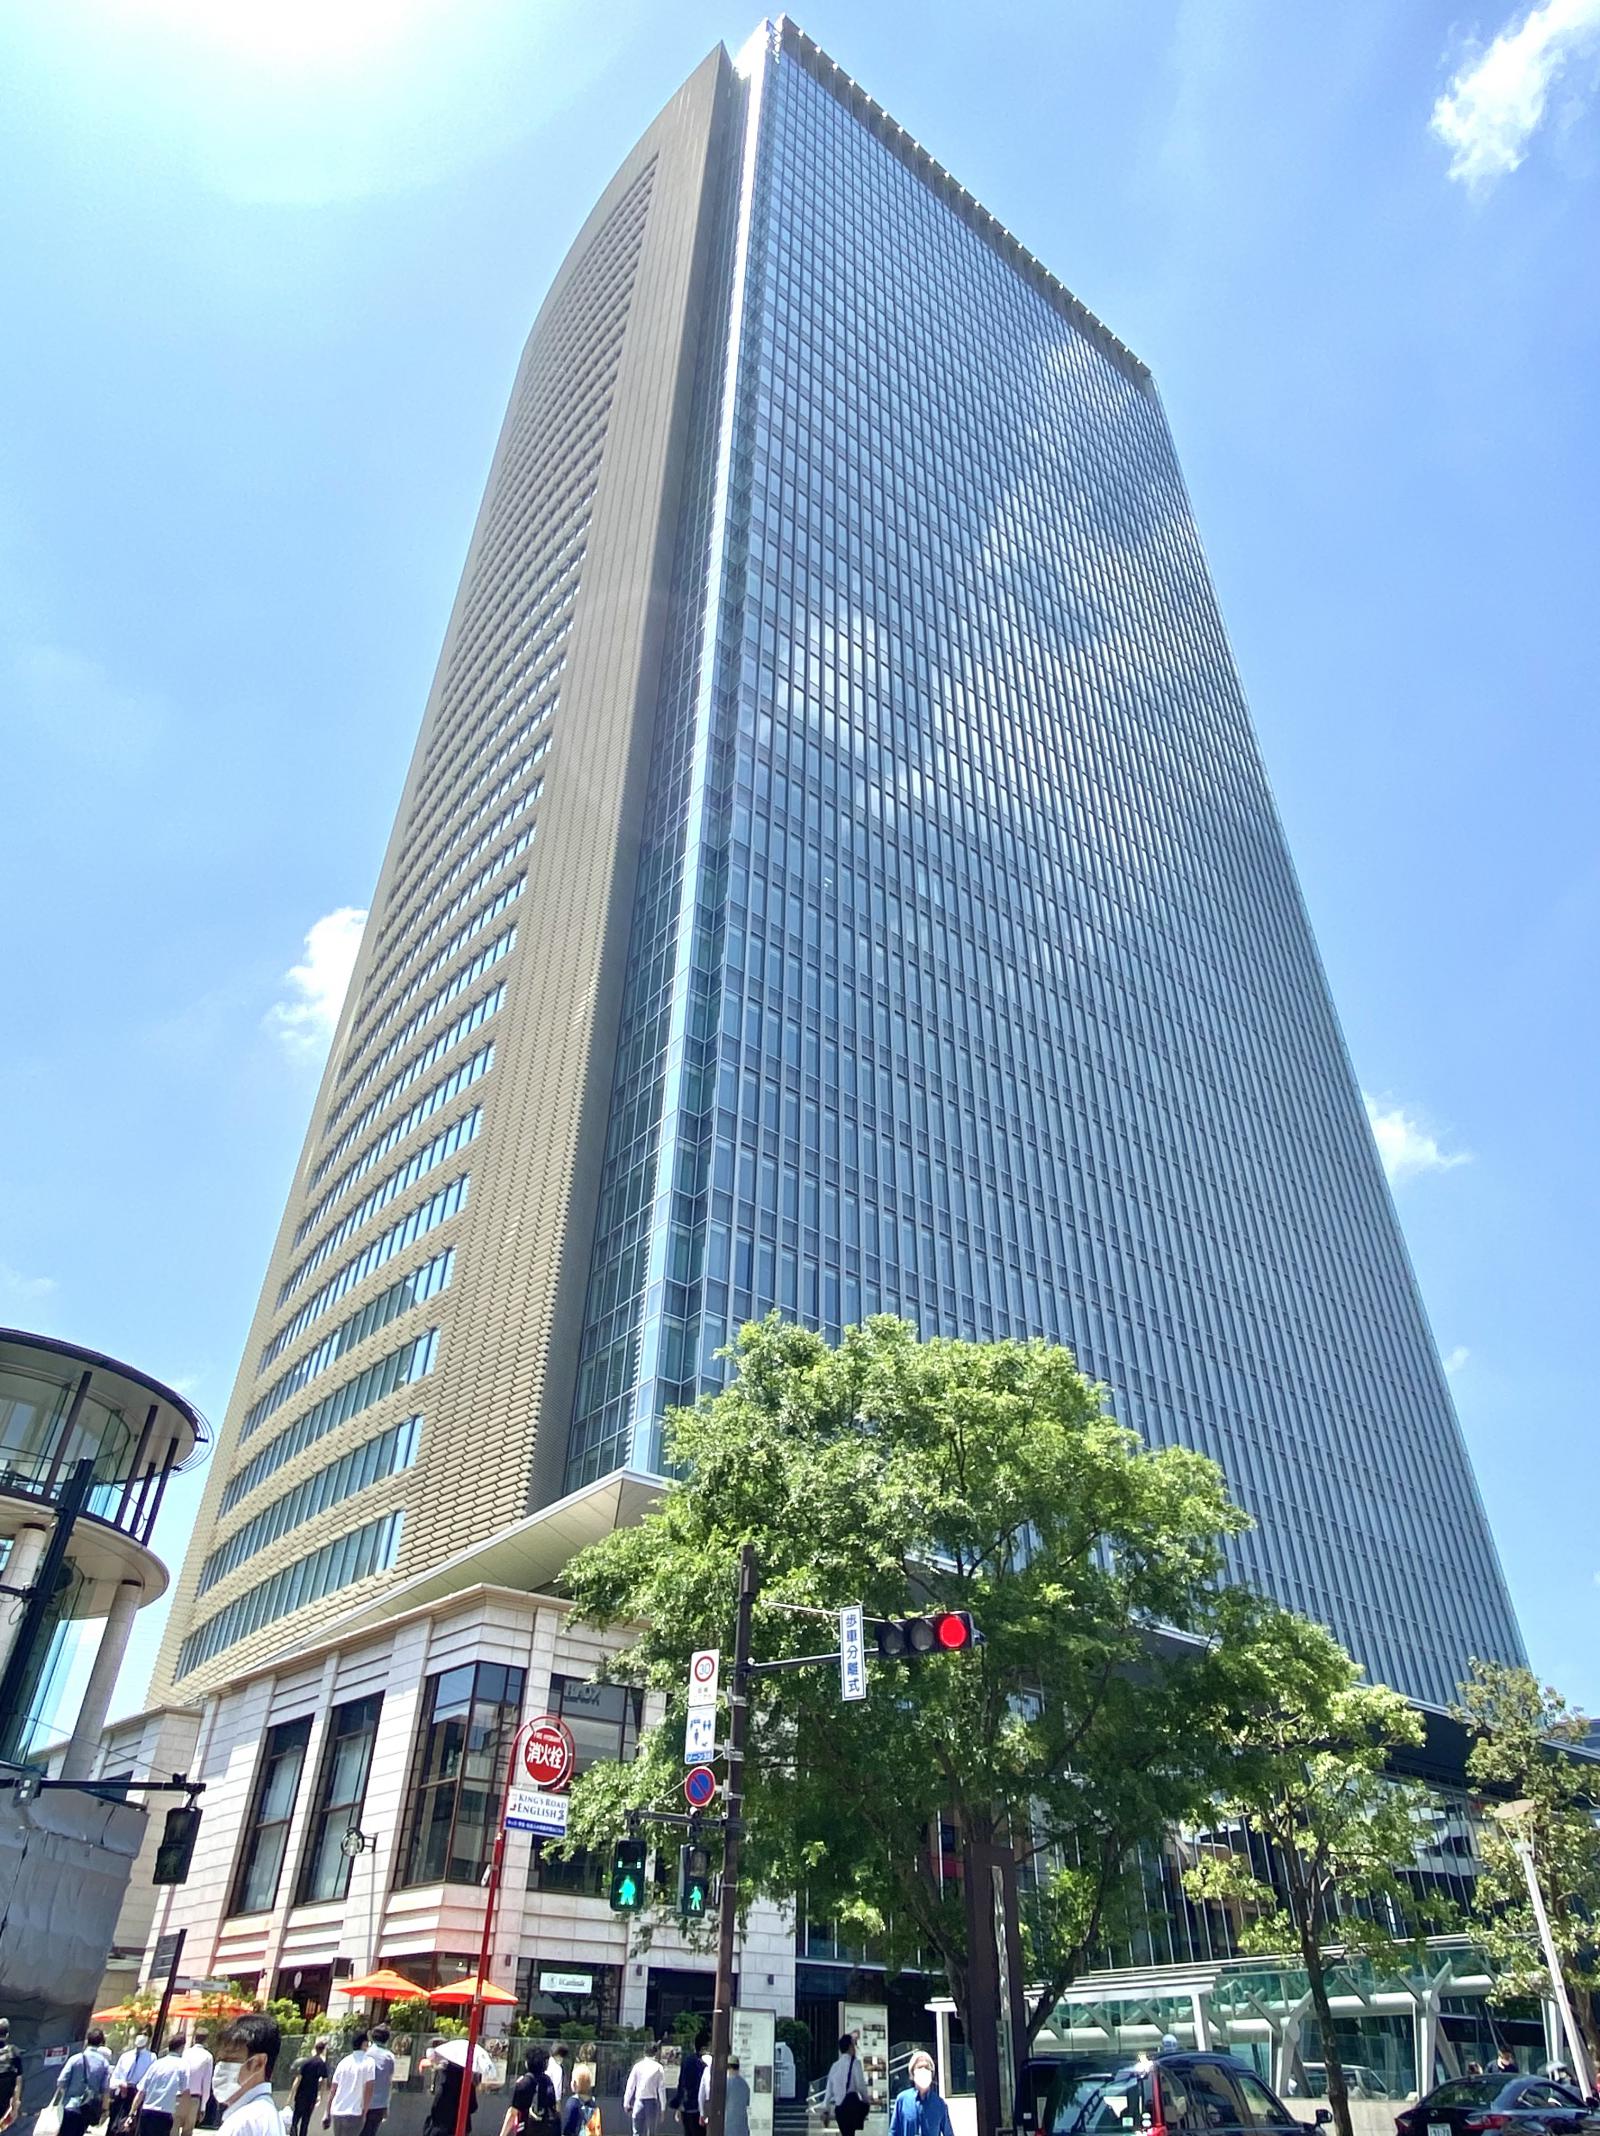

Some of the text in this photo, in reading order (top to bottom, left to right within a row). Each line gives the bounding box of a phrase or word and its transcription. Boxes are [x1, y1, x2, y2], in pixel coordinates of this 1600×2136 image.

[846, 1614, 860, 1692] 歩車分離式
[699, 1663, 711, 1675] 30
[527, 1741, 564, 1769] 消火栓
[518, 1793, 567, 1809] KING'S ROAD
[517, 1803, 557, 1819] ENGLISH
